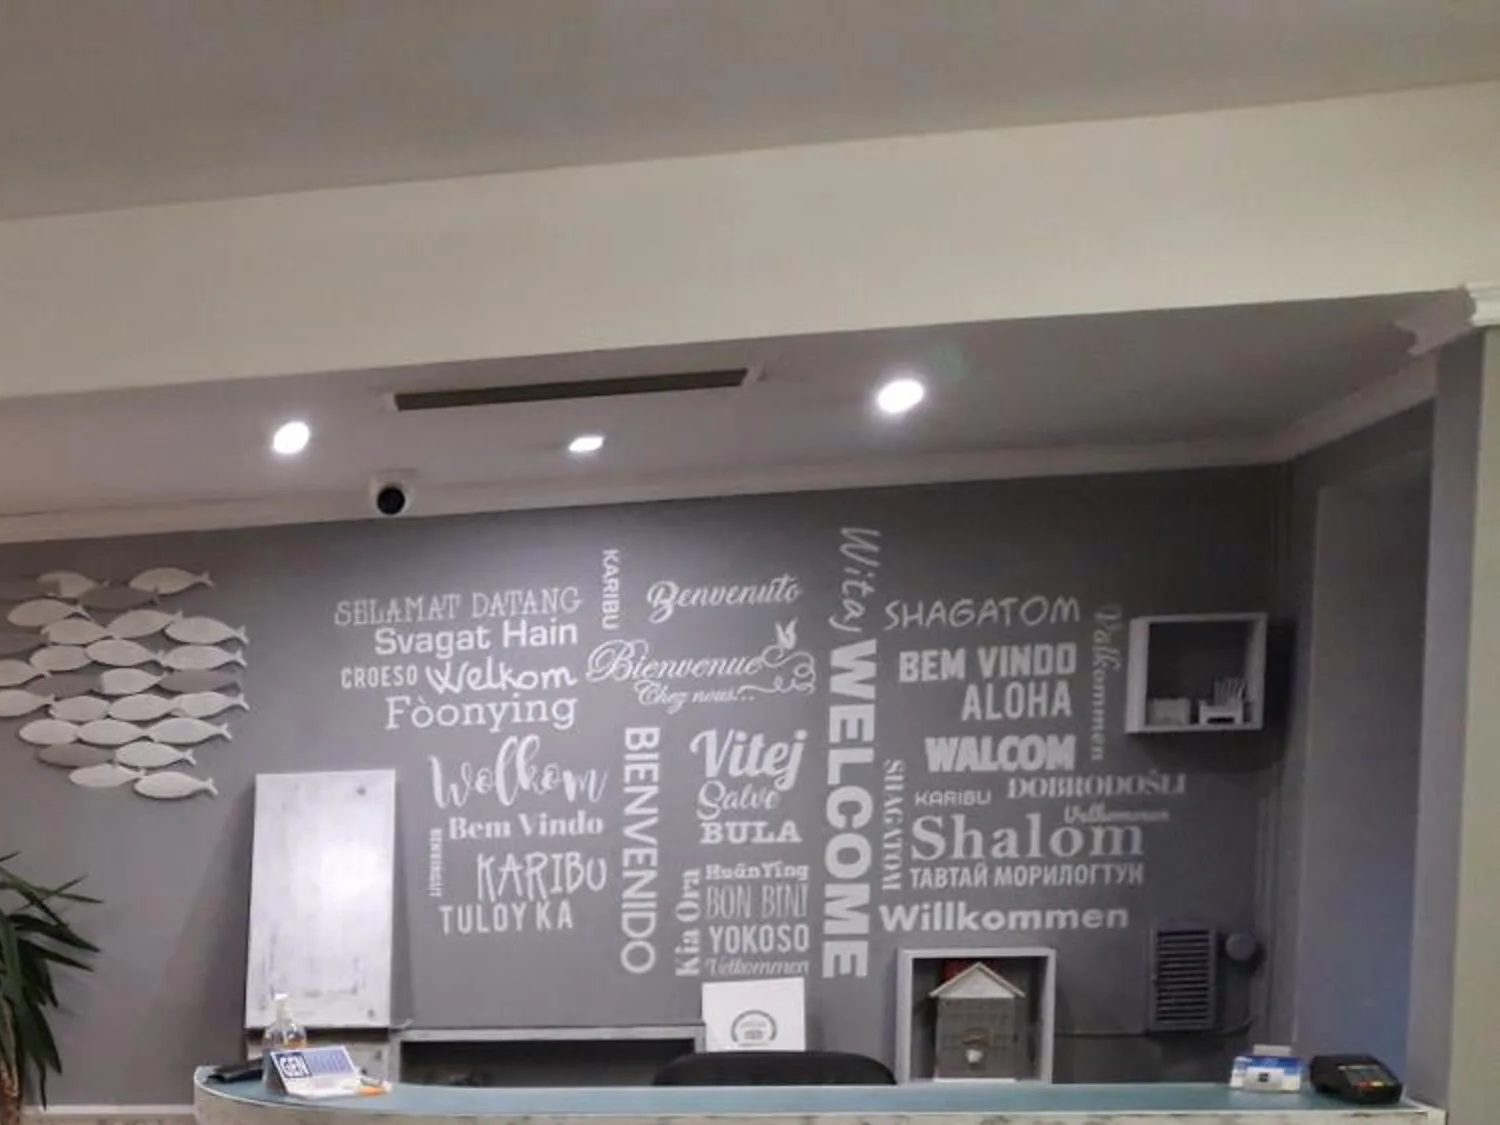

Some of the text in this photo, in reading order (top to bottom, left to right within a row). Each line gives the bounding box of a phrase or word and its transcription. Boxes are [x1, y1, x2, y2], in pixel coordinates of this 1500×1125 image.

[602, 549, 620, 630] KARIBU
[647, 574, 803, 624] Benvenuto
[829, 526, 881, 632] Witaj
[334, 586, 581, 626] SELAMAT DATANG
[883, 596, 1080, 631] SHAGATOM
[374, 618, 578, 660] Svagat Hain
[340, 656, 578, 694] CROESO Welkom
[586, 639, 764, 682] Bienvenue
[899, 641, 1076, 682] BEM VINDO
[961, 679, 1072, 721] ALOHA
[689, 729, 808, 791] Vitej
[924, 735, 1076, 773] WALCOM
[696, 780, 781, 821] Salve
[821, 638, 878, 979] WELCOME
[450, 809, 605, 840] Bem Vindo
[700, 820, 804, 844] BULA
[911, 813, 1144, 861] Shalom
[620, 727, 660, 974] BIENVENIDO
[476, 852, 608, 902] KARIBU
[438, 899, 573, 935] TULOY KA
[706, 881, 809, 920] BON BINI
[879, 901, 1129, 932] Willkommen
[675, 868, 700, 976] Kia Ora
[709, 924, 810, 954] YOKOSO
